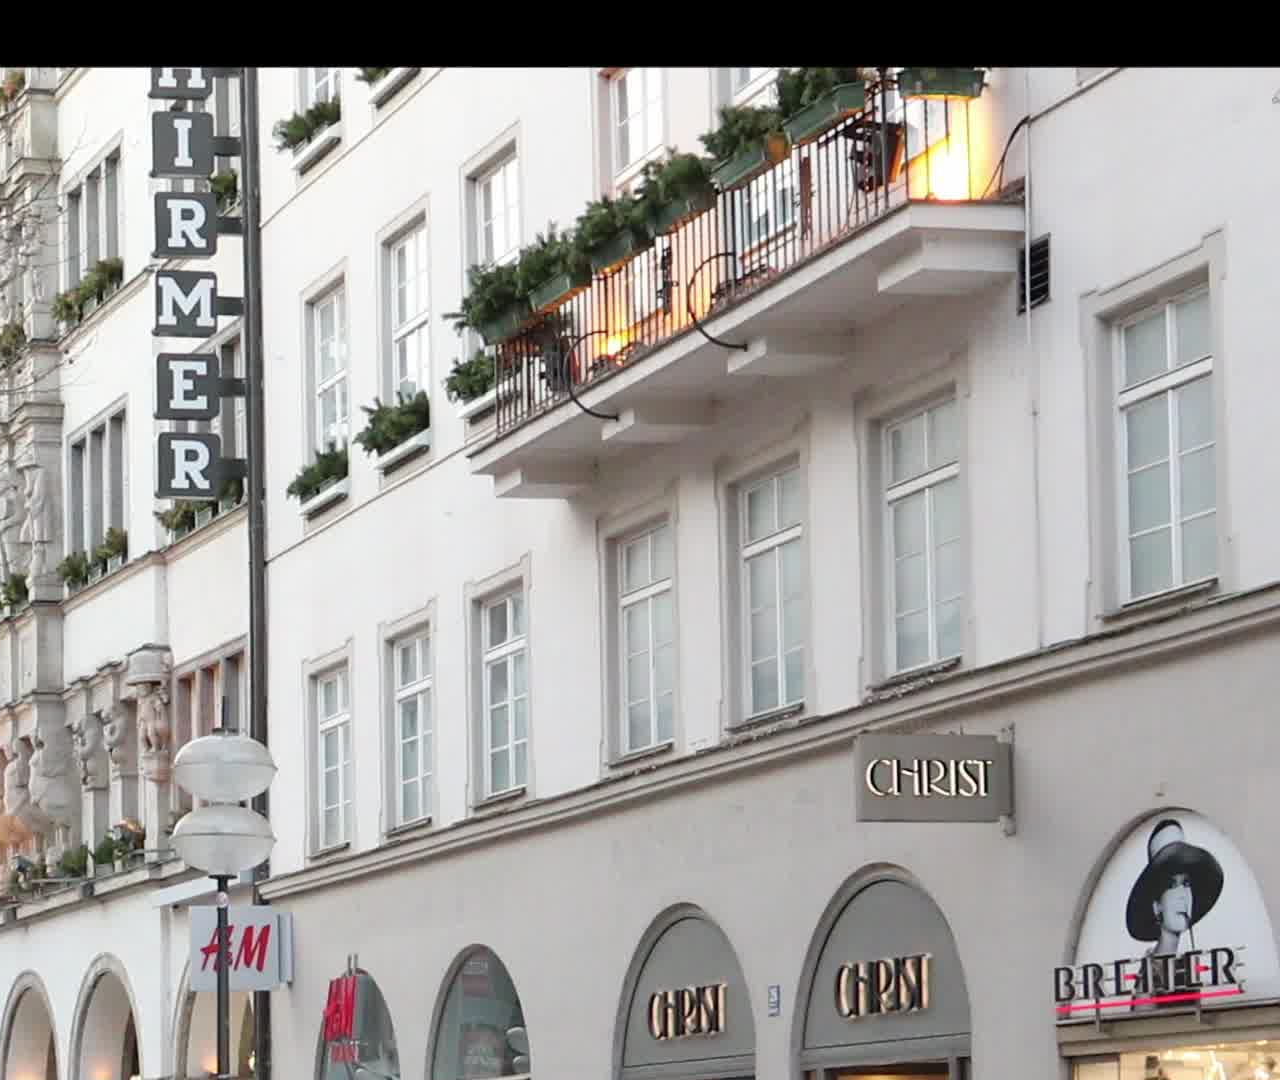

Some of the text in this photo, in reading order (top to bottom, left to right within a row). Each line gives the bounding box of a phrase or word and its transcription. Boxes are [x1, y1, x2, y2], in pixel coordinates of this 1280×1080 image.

[865, 758, 993, 797] CHRIST
[834, 952, 933, 1018] CHRIST
[1053, 946, 1237, 1001] BREITER
[647, 983, 728, 1041] CHRIST
